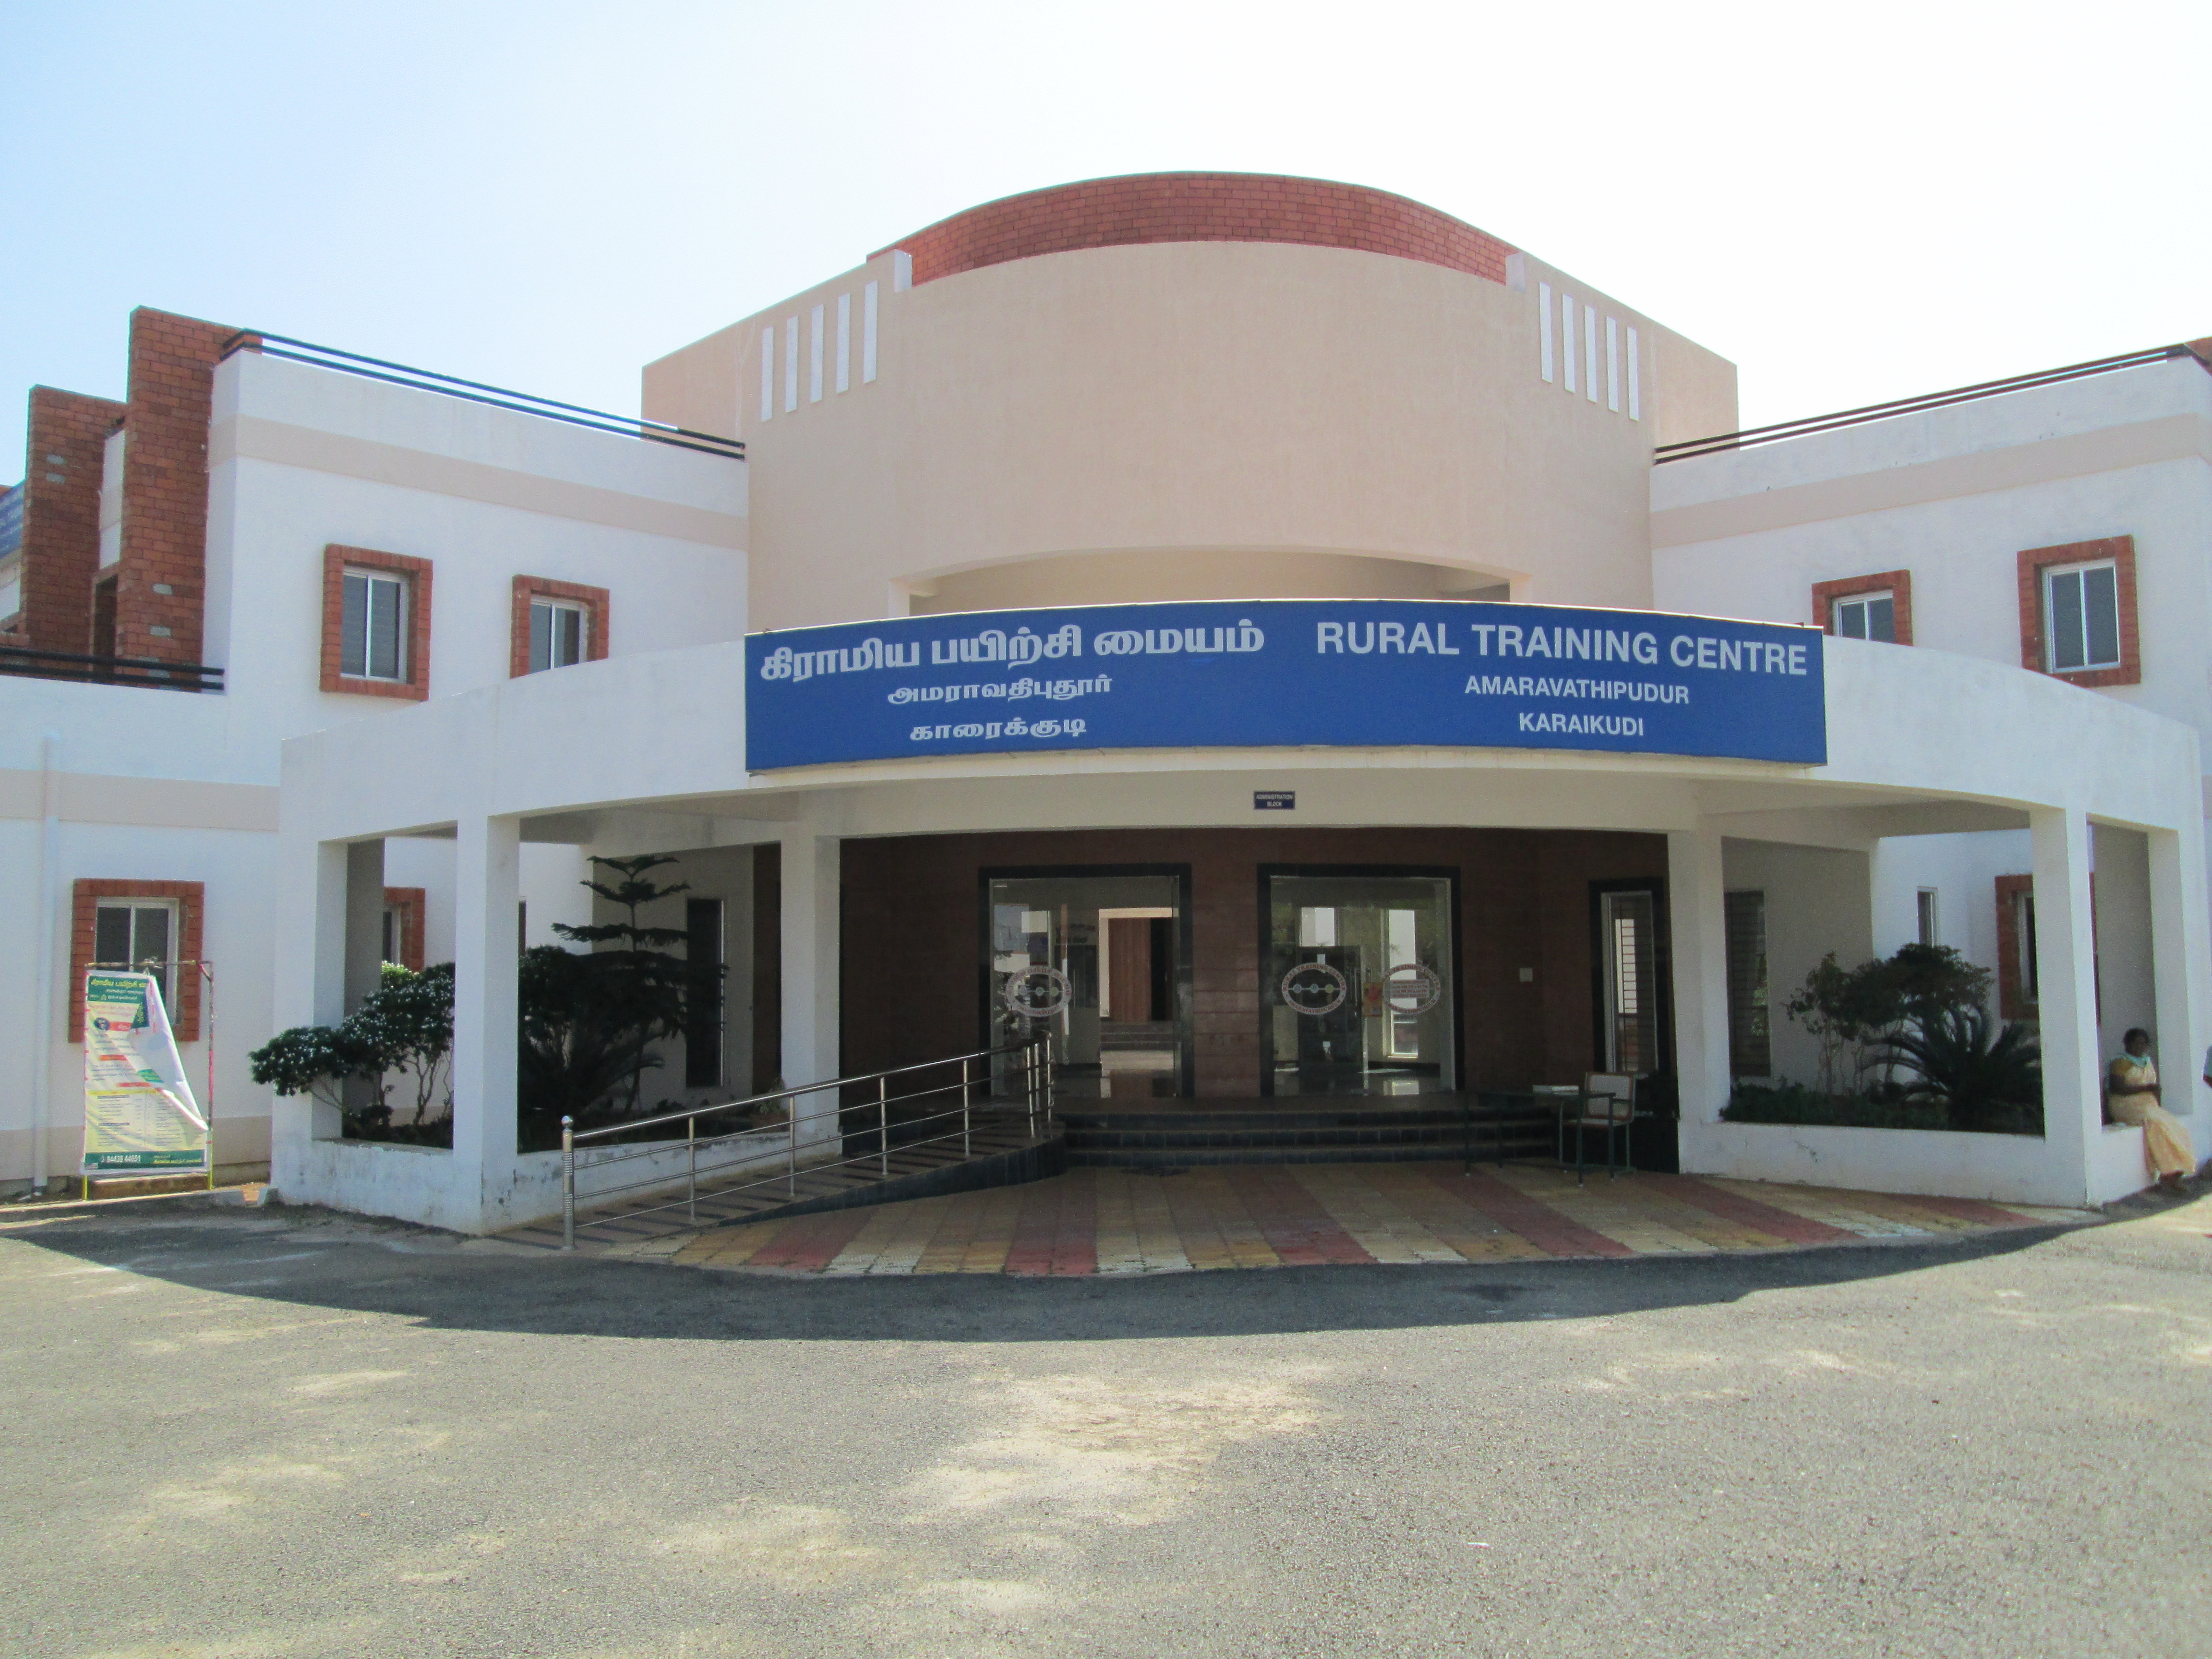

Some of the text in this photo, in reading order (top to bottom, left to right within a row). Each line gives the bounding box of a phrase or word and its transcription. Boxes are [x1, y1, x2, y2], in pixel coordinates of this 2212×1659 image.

[760, 619, 1264, 682] கிராமிய பயிற்சி மையம்
[1317, 622, 1807, 675] RURAL TRAINING CENTRE
[888, 674, 1112, 704] அமராவதிபுதூர்
[1465, 675, 1689, 704] AMARAVATHIPUDUR
[910, 717, 1087, 740] காரைக்குடி
[1519, 712, 1644, 736] KARAIKUDI
